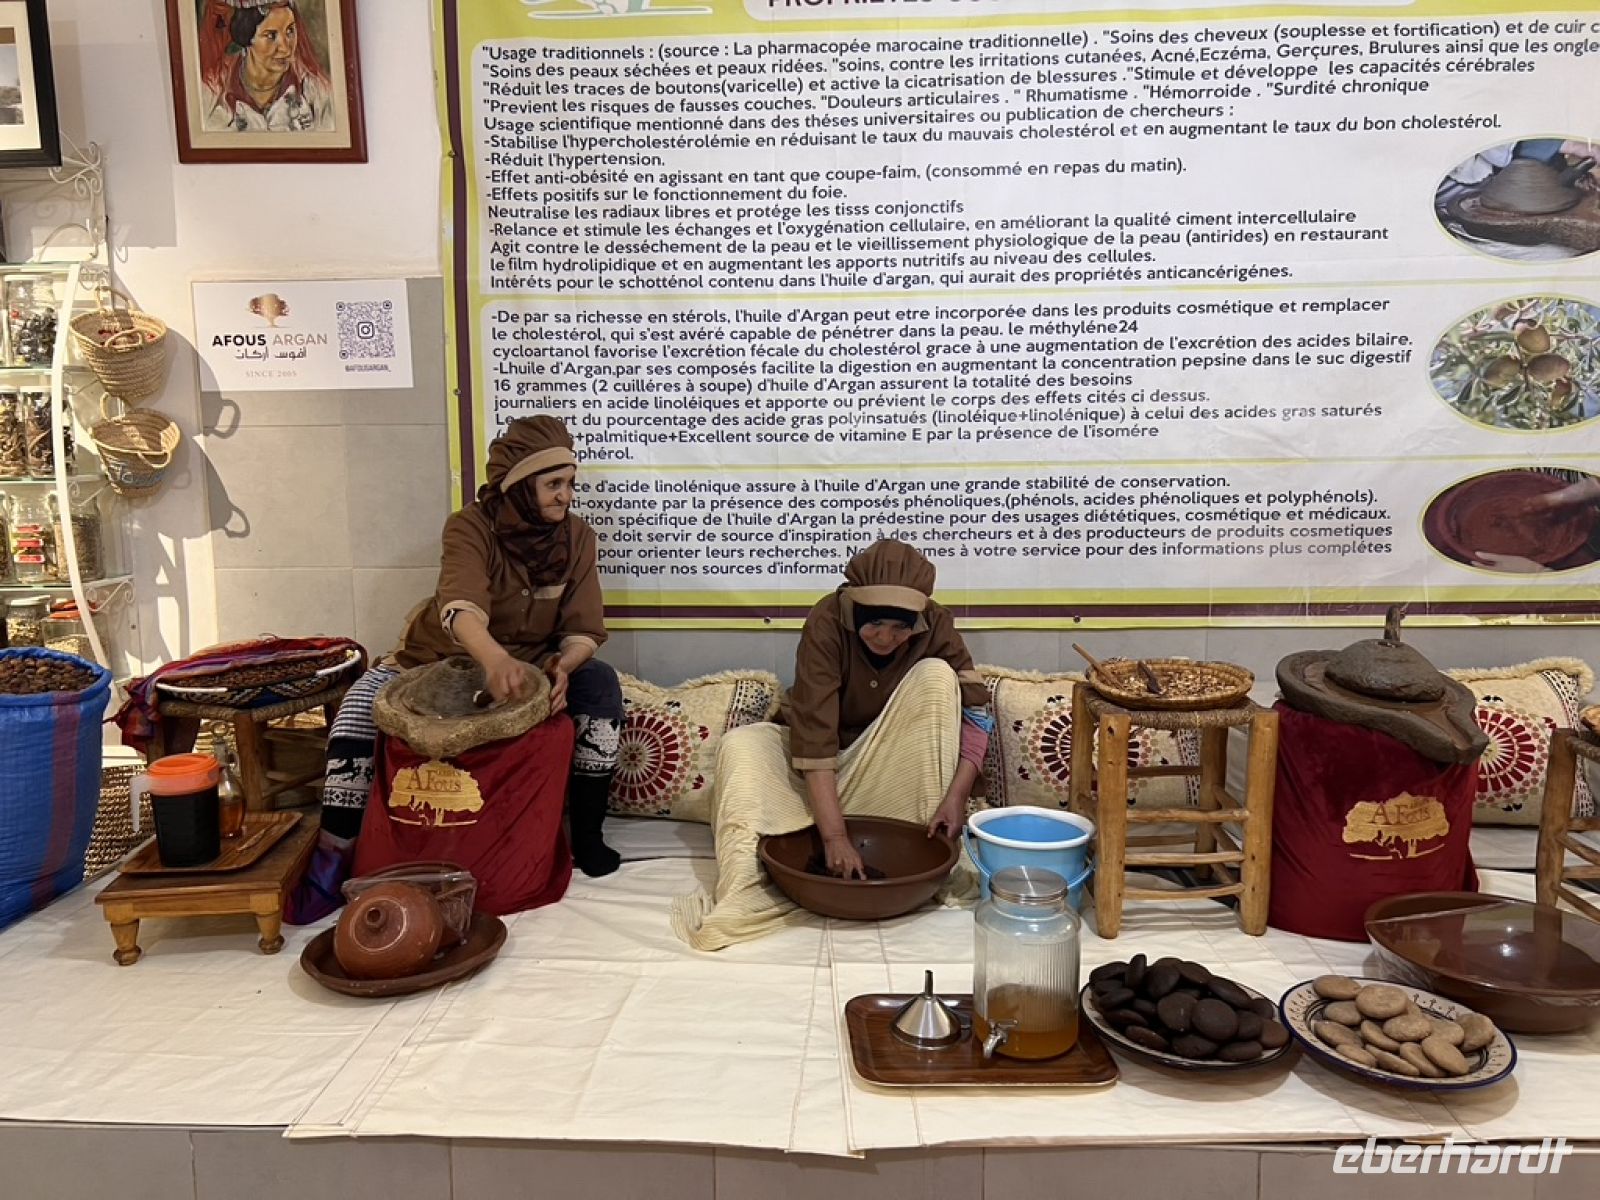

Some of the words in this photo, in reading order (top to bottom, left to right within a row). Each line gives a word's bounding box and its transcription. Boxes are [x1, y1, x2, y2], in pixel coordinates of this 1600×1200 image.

[482, 46, 537, 63] "Usage
[542, 45, 645, 60] traditionnels
[658, 43, 720, 62] (source
[734, 42, 752, 55] La
[758, 38, 871, 59] pharmacopée
[876, 37, 963, 52] marocaine
[969, 30, 1088, 49] traditionnelle)
[1103, 29, 1154, 44] "Soins
[1159, 29, 1189, 44] des
[1194, 28, 1268, 43] cheveux
[1274, 23, 1366, 43] (souplesse
[1371, 25, 1389, 36] et
[1393, 20, 1500, 38] fortification)
[1506, 21, 1523, 34] et
[1528, 19, 1550, 34] de
[1554, 19, 1586, 34] cuir
[484, 117, 535, 135] Usage
[539, 116, 631, 133] scientifique
[637, 115, 724, 131] mentionné
[728, 115, 766, 129] dans
[771, 114, 800, 129] des
[864, 109, 975, 126] universitaires
[980, 112, 1000, 122] ou
[1006, 105, 1097, 125] publication
[1103, 104, 1124, 118] de
[1130, 103, 1224, 118] chercheurs
[484, 152, 543, 167] -Réduit
[548, 152, 665, 170] l'hypertension.
[486, 186, 538, 202] -Effets
[543, 187, 599, 205] positifs
[604, 190, 628, 201] sur
[633, 187, 649, 200] le
[654, 187, 782, 201] fonctionnement
[787, 186, 807, 200] du
[812, 185, 847, 199] foie.
[488, 205, 570, 219] Neutralise
[575, 206, 598, 219] les
[603, 204, 660, 219] radiaux
[665, 205, 710, 219] libres
[715, 207, 732, 218] et
[807, 203, 830, 217] les
[835, 202, 870, 216] tisss
[875, 199, 964, 218] conjonctifs
[490, 239, 520, 257] Agit
[526, 243, 579, 254] contre
[584, 241, 600, 254] le
[726, 240, 747, 253] de
[752, 240, 766, 253] la
[771, 242, 810, 256] peau
[815, 240, 832, 252] et
[837, 237, 852, 251] le
[857, 236, 970, 250] vieillissement
[975, 232, 1088, 251] physiologique
[1094, 231, 1115, 245] de
[1120, 231, 1134, 245] la
[1139, 233, 1180, 248] peau
[1186, 228, 1268, 247] (antirides)
[1274, 232, 1295, 242] en
[1300, 228, 1389, 241] restaurant
[490, 258, 505, 271] le
[508, 257, 538, 271] film
[543, 258, 657, 275] hydrolipidique
[661, 259, 678, 271] et
[683, 261, 703, 270] en
[708, 258, 803, 274] augmentant
[808, 256, 831, 269] les
[836, 257, 897, 272] apports
[903, 252, 965, 267] nutritifs
[970, 255, 988, 266] au
[994, 251, 1047, 265] niveau
[1053, 250, 1082, 264] des
[1087, 249, 1156, 263] cellules.
[212, 334, 267, 347] AFOUS
[272, 333, 328, 346] ARGAN
[492, 344, 589, 361] cycloartanol
[594, 345, 658, 358] favorise
[663, 344, 746, 358] l'excrétion
[750, 344, 799, 357] fécale
[804, 343, 824, 357] du
[829, 342, 921, 356] cholestérol
[926, 344, 972, 358] grace
[976, 340, 985, 353] à
[990, 343, 1021, 353] une
[1026, 337, 1138, 356] augmentation
[1143, 337, 1164, 350] de
[1170, 335, 1257, 350] l'excrétion
[1262, 335, 1292, 348] des
[1297, 333, 1350, 347] acides
[1356, 332, 1413, 346] bilaire.
[494, 379, 511, 391] 16
[517, 382, 587, 396] grammes
[592, 379, 608, 395] (2
[686, 379, 694, 392] à
[699, 378, 752, 395] soupe)
[757, 378, 809, 391] d'huile
[814, 378, 875, 394] d'Argan
[880, 378, 948, 390] assurent
[954, 375, 967, 388] la
[972, 374, 1031, 388] totalité
[1036, 374, 1065, 387] des
[1070, 372, 1133, 386] besoins
[595, 480, 650, 493] d'acide
[655, 479, 741, 496] linolénique
[746, 482, 796, 492] assure
[801, 479, 810, 492] à
[815, 479, 860, 492] l'huile
[865, 478, 925, 495] d'Argan
[930, 481, 960, 491] une
[965, 477, 1021, 494] grande
[1026, 475, 1089, 489] stabilité
[1094, 475, 1115, 488] de
[1120, 474, 1230, 488] conservation.
[618, 512, 698, 529] spécifique
[702, 513, 722, 525] de
[727, 512, 772, 525] l'huile
[777, 512, 836, 529] d'Argan
[842, 512, 854, 525] la
[859, 511, 944, 528] prédestine
[950, 514, 987, 527] pour
[991, 510, 1020, 523] des
[1025, 512, 1079, 526] usages
[1185, 507, 1281, 524] cosmétique
[1286, 509, 1304, 521] et
[1309, 506, 1391, 520] médicaux.
[670, 565, 697, 575] nos
[702, 565, 763, 575] sources
